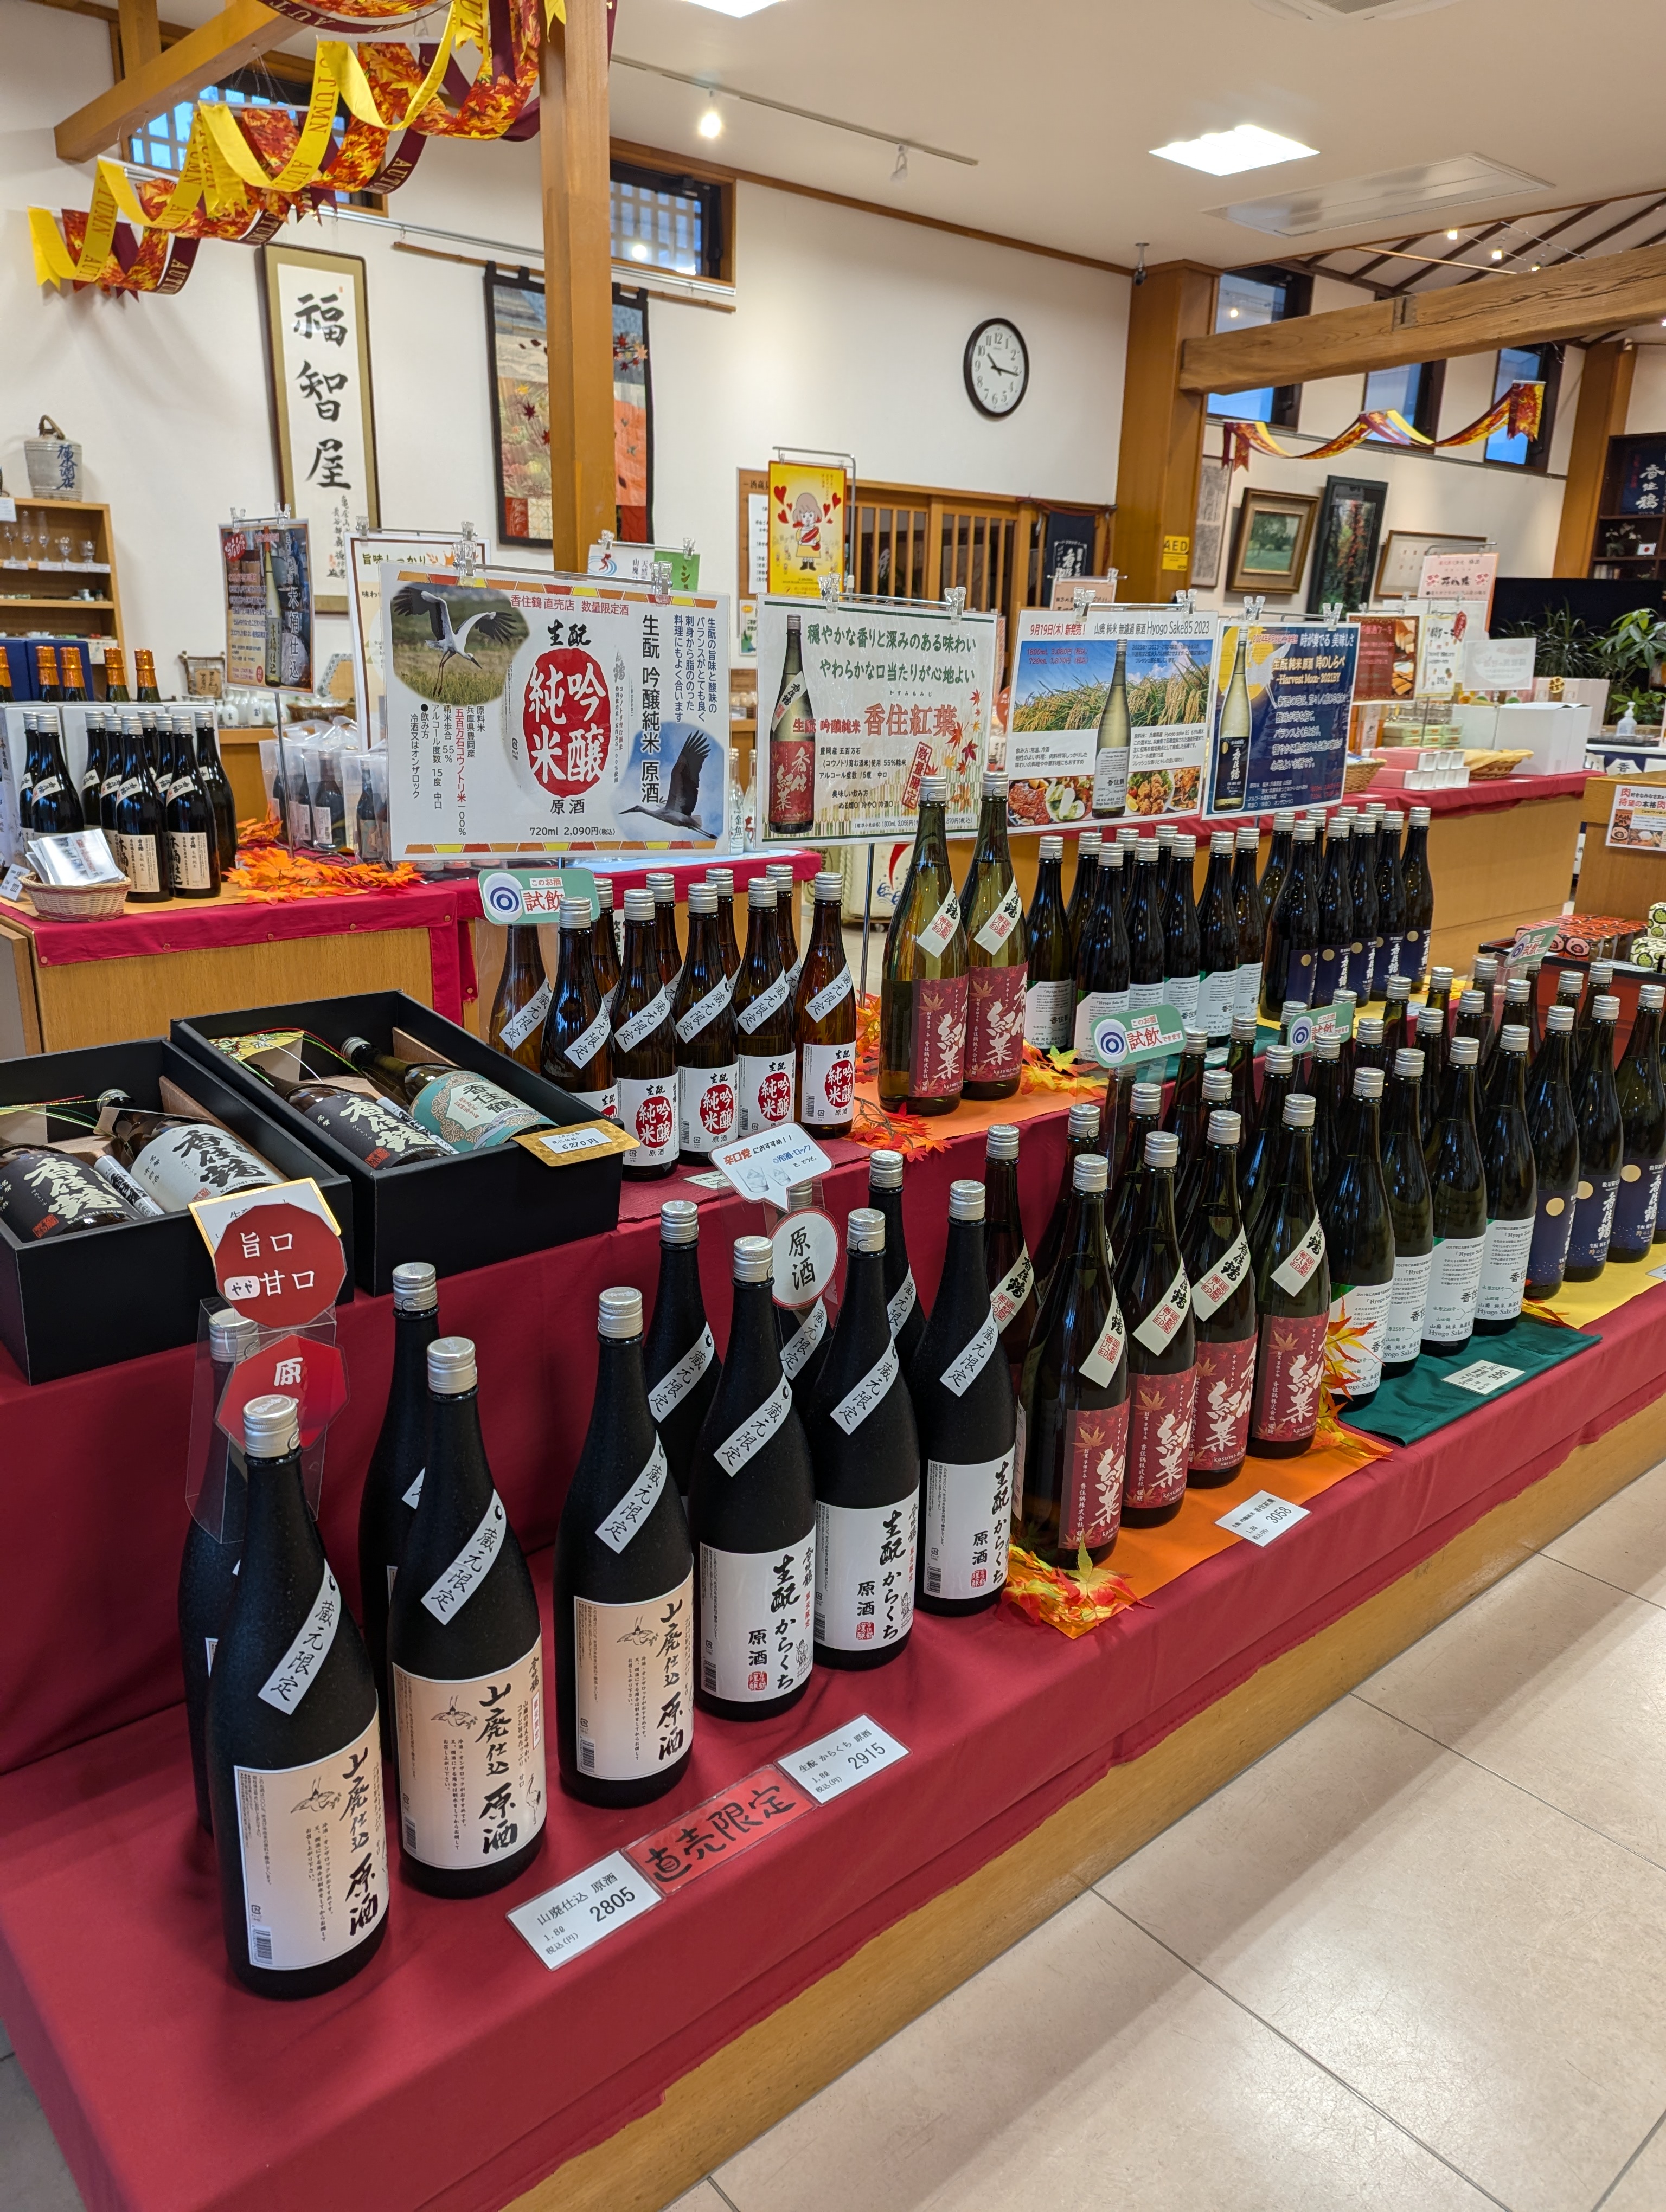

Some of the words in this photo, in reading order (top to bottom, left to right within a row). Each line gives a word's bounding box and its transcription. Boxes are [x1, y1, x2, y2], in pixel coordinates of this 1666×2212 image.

[977, 346, 986, 356] 10
[985, 335, 992, 346] 11
[994, 333, 1003, 343] 12
[1005, 338, 1010, 349] 1
[1011, 349, 1016, 361] 2
[975, 361, 981, 371] 9
[977, 376, 983, 387] 8
[293, 293, 351, 490] 福智屋
[984, 389, 990, 400] 7
[992, 394, 998, 404] 6
[1001, 391, 1007, 402] 5
[1009, 382, 1014, 392] 4
[1163, 541, 1188, 551] AED
[511, 595, 542, 608] 香住鶴
[543, 598, 574, 611] 直売店
[581, 601, 629, 616] 数量限定酒
[548, 619, 592, 646] 生酛
[642, 614, 660, 659] 生酛
[807, 623, 977, 654] 穏やかな香りと深みのある味わい
[1030, 624, 1064, 635] 9月19日(木)
[1106, 625, 1117, 635] 純米
[1136, 623, 1146, 635] 原酒
[1148, 621, 1168, 635] Hyogo
[1169, 621, 1193, 634] Sake85
[1194, 621, 1209, 634] 2023
[1331, 633, 1355, 647] 美味しさ
[674, 614, 683, 723] 料理にもよく合います
[685, 616, 695, 711] 刺身から脂ののった
[696, 616, 706, 722] バランスがとても良く
[708, 618, 717, 713] 生酛の旨味と酸味の
[819, 659, 975, 685] やわらかな口当たりが心地よい
[1315, 655, 1345, 670] 時のしらべ
[443, 704, 452, 740] 精米歩合
[477, 706, 485, 732] 原料米
[528, 664, 566, 783] 純米
[642, 667, 661, 754] 吟醸純米
[820, 719, 861, 734] 吟醸純米
[864, 703, 958, 737] 香住紅葉
[432, 704, 441, 764] アルコール度数
[466, 705, 475, 758] 兵庫県豊岡産
[410, 713, 420, 799] 冷酒又はオンザロック
[443, 745, 454, 763] 55%
[820, 747, 837, 755] 豊岡産
[840, 747, 861, 755] 五百万石
[432, 769, 443, 786] 15度
[641, 761, 659, 803] 原酒
[819, 771, 857, 780] アルコール度数
[434, 792, 442, 809] 中口
[550, 799, 585, 814] 原酒
[832, 790, 868, 798] 美味しい飲み方
[530, 827, 558, 836] 720ml
[564, 826, 615, 836] 2,090円(税込)
[523, 890, 564, 912] 試飲
[742, 983, 786, 1028] 蔵元限定
[810, 973, 850, 1016] 蔵元限定
[619, 1000, 668, 1046] 蔵元限定
[680, 991, 726, 1036] 蔵元限定
[1132, 1015, 1157, 1027] このお酒
[1127, 1027, 1162, 1051] 試飲
[1162, 1032, 1182, 1041] できます
[463, 1083, 519, 1114] 香住鶴
[702, 1091, 719, 1132] 純米
[761, 1080, 777, 1118] 純米
[340, 1097, 436, 1152] 香住鶴
[639, 1103, 656, 1145] 純米
[712, 1135, 728, 1143] 原酒
[172, 1129, 267, 1188] 香住鶴
[649, 1149, 665, 1157] 原酒
[24, 1157, 123, 1219] 香住鶴
[1598, 1192, 1616, 1240] 香住鶴
[239, 1232, 293, 1258] 旨口
[788, 1226, 817, 1291] 原酒
[1220, 1240, 1250, 1283] 香住鶴
[231, 1280, 254, 1296] やや
[259, 1269, 316, 1296] 甘口
[1004, 1253, 1034, 1298] 香住鶴
[947, 1324, 997, 1389] 蔵元限定
[651, 1347, 708, 1414] 蔵元限定
[1488, 1369, 1510, 1380] 3080
[839, 1359, 895, 1427] 蔵元限定
[722, 1397, 784, 1468] 蔵元限定
[605, 1463, 663, 1542] 蔵元限定
[1254, 1498, 1276, 1513] 香住紅葉
[1266, 1507, 1292, 1523] 3058
[972, 1530, 989, 1565] 原酒
[993, 1519, 1007, 1584] からくち
[431, 1526, 496, 1613] 蔵元限定
[857, 1581, 875, 1616] 原酒
[882, 1571, 902, 1639] からくち
[270, 1599, 335, 1702] 蔵元限定
[656, 1599, 683, 1688] 山廃仕込
[748, 1629, 767, 1666] 原酒
[775, 1618, 796, 1690] からくち
[476, 1683, 512, 1777] 山廃仕込
[657, 1692, 684, 1761] 原酒
[818, 1740, 853, 1763] からくち
[854, 1729, 873, 1743] 原酒
[847, 1741, 886, 1771] 2915
[339, 1747, 370, 1854] 山廃仕込
[815, 1775, 843, 1793] 税込(円)
[479, 1782, 518, 1854] 原酒
[644, 1785, 797, 1883] 直売限定
[345, 1853, 379, 1936] 原酒
[537, 1891, 589, 1926] 山廃仕込
[591, 1872, 619, 1894] 原酒
[589, 1886, 636, 1924] 2805
[545, 1931, 579, 1956] 税込(円)
